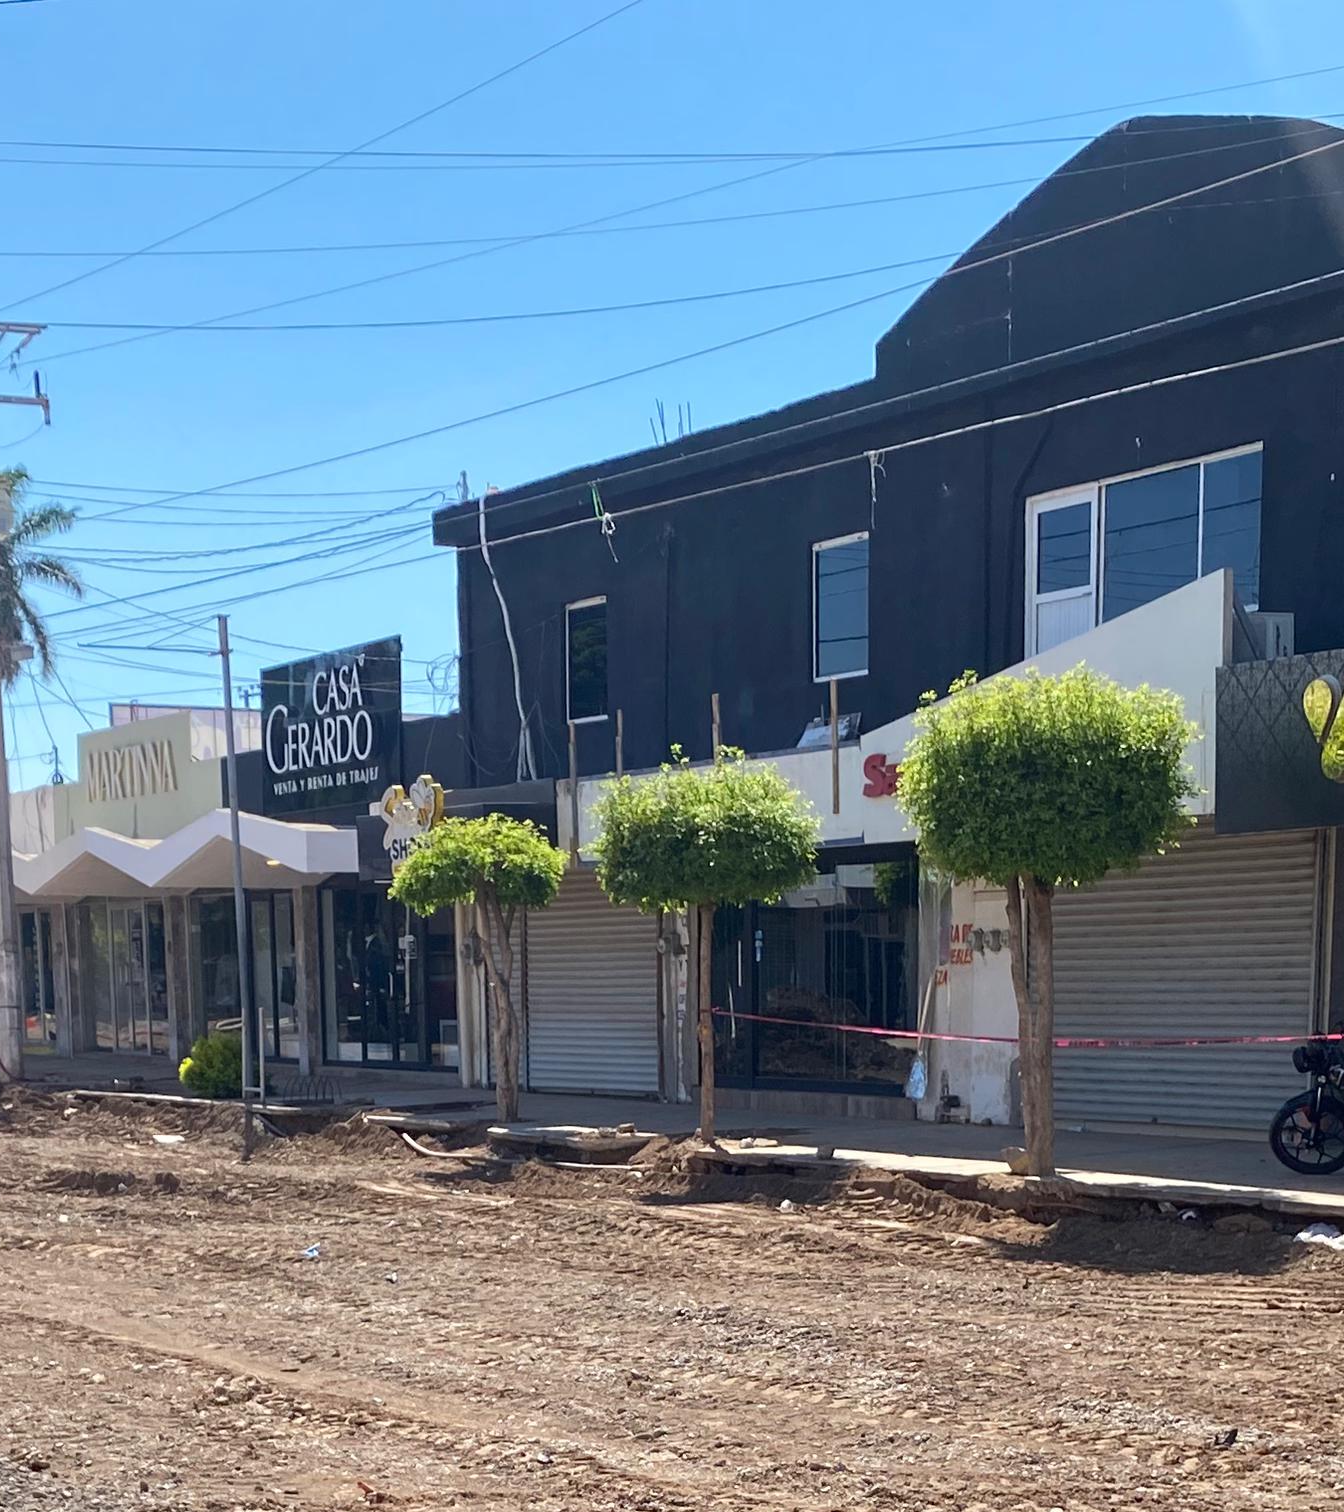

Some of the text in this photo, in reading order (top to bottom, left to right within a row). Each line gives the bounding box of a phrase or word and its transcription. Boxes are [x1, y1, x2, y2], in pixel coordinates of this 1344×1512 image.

[312, 664, 363, 716] CASA
[266, 703, 373, 775] GERARDO
[273, 766, 379, 796] VENTA Y RENTA DE TRAJES
